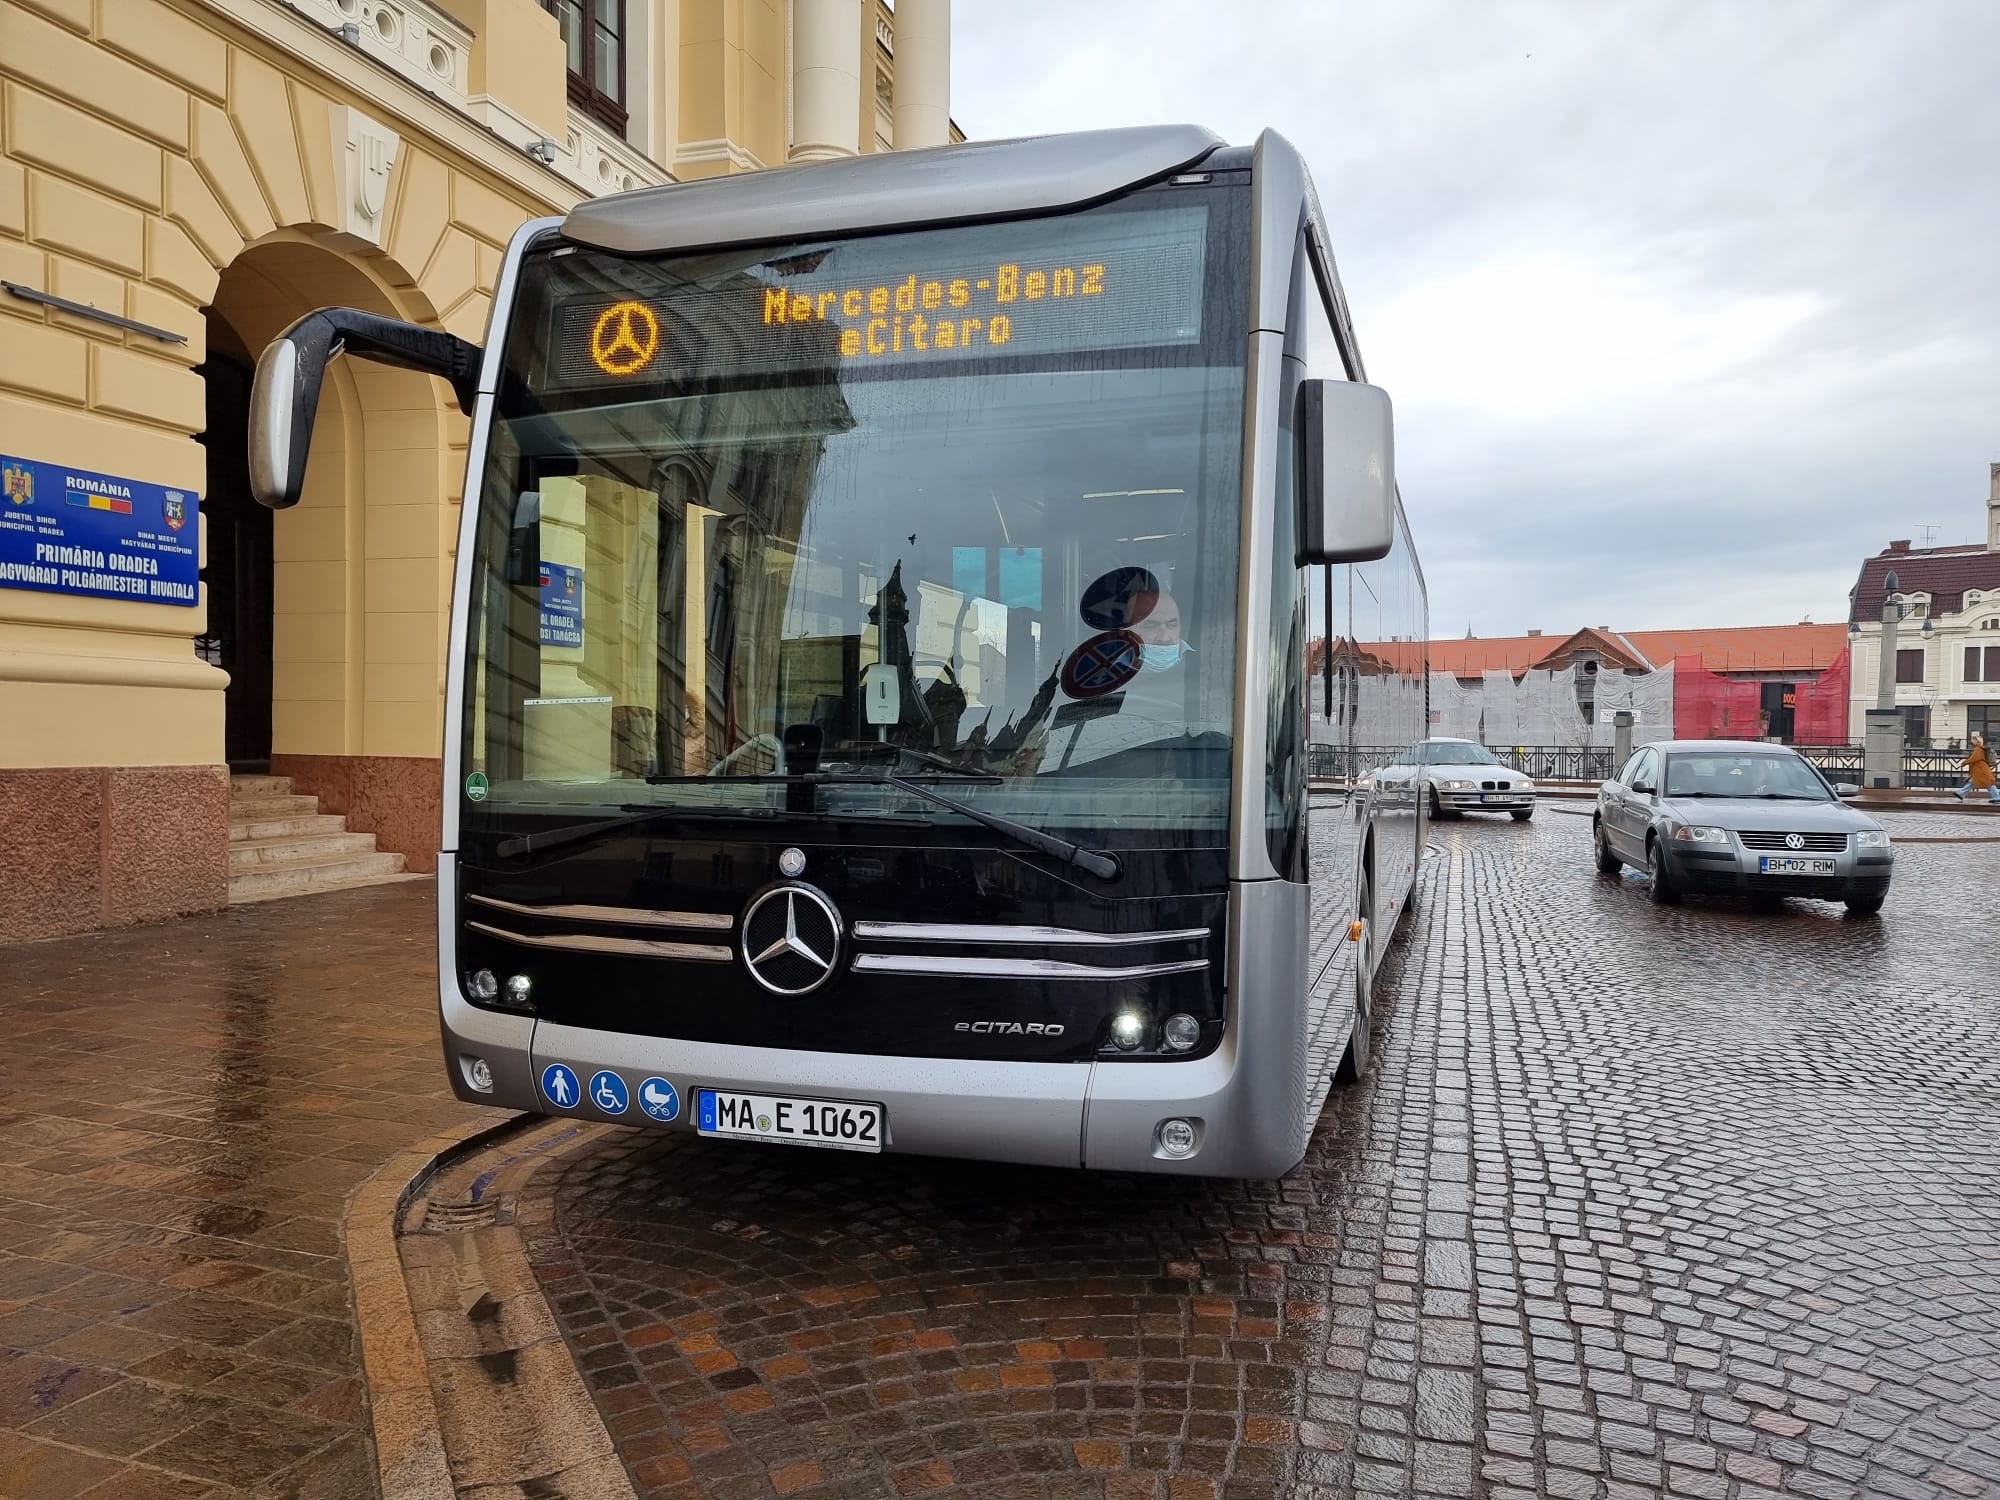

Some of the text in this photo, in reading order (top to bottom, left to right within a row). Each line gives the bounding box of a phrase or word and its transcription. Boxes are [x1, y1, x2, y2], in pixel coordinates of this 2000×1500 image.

[764, 263, 1105, 324] Mercedes-Benz
[840, 313, 1011, 356] eCitaro
[66, 476, 131, 498] ROMÂNIA
[38, 526, 65, 537] ORADEA
[36, 543, 158, 576] PRIMĂRIA ORADEA
[62, 568, 147, 595] POLGÁRMESTERI
[150, 580, 194, 600] HIVATALA
[550, 614, 575, 628] ORADEA
[1768, 859, 1833, 872] BH 02 RIM
[954, 1021, 1065, 1036] eCITARO
[705, 1114, 712, 1123] D
[718, 1097, 877, 1142] MA E 1062
